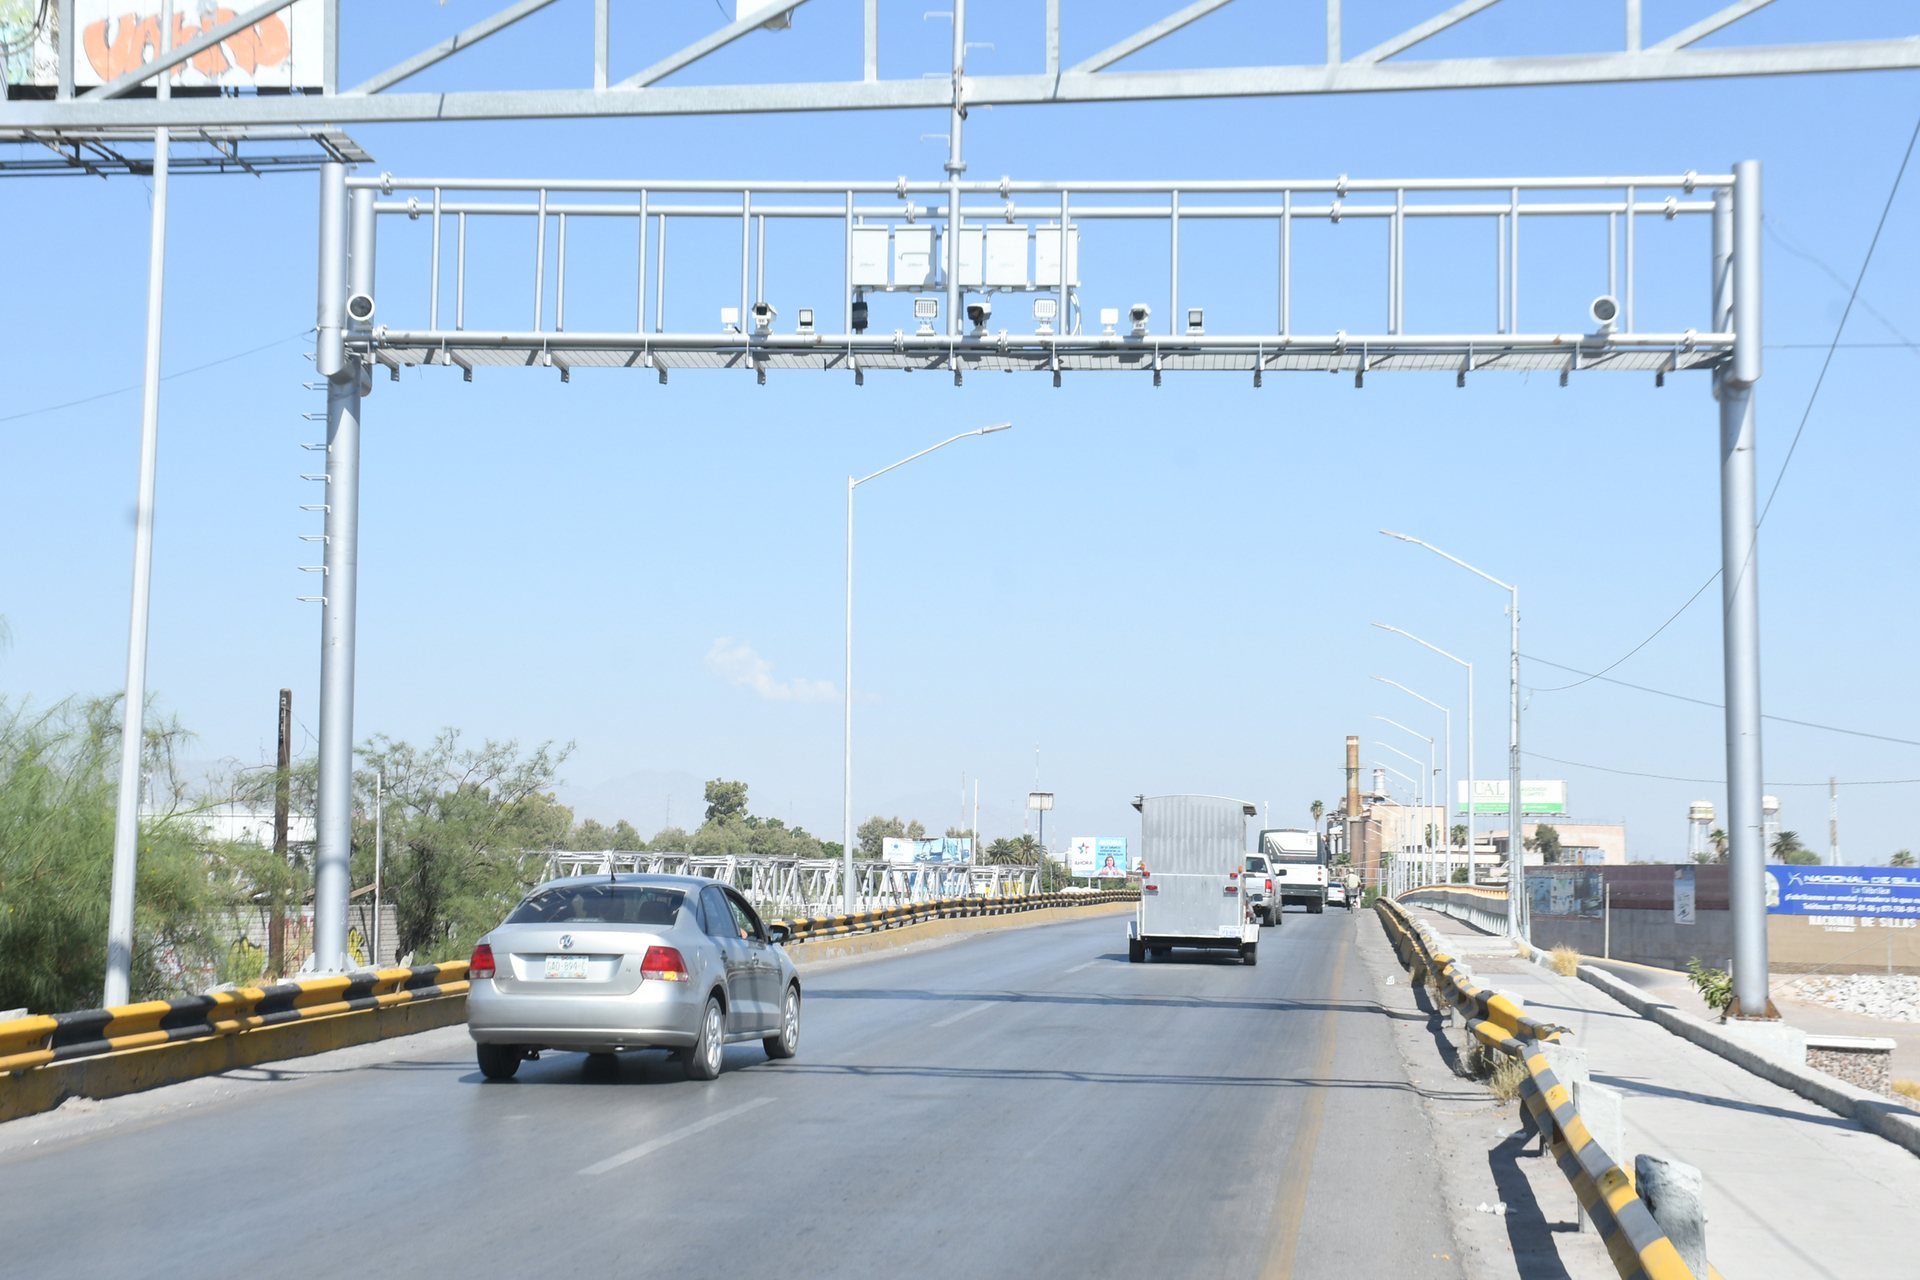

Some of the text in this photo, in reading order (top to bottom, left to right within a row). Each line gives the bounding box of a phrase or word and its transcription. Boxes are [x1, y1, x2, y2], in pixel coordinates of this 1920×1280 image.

[1474, 782, 1506, 795] UAL
[1803, 875, 1870, 883] NACIONAL
[1870, 876, 1891, 884] DE
[1809, 915, 1918, 928] NACIONAL DE SILLAS
